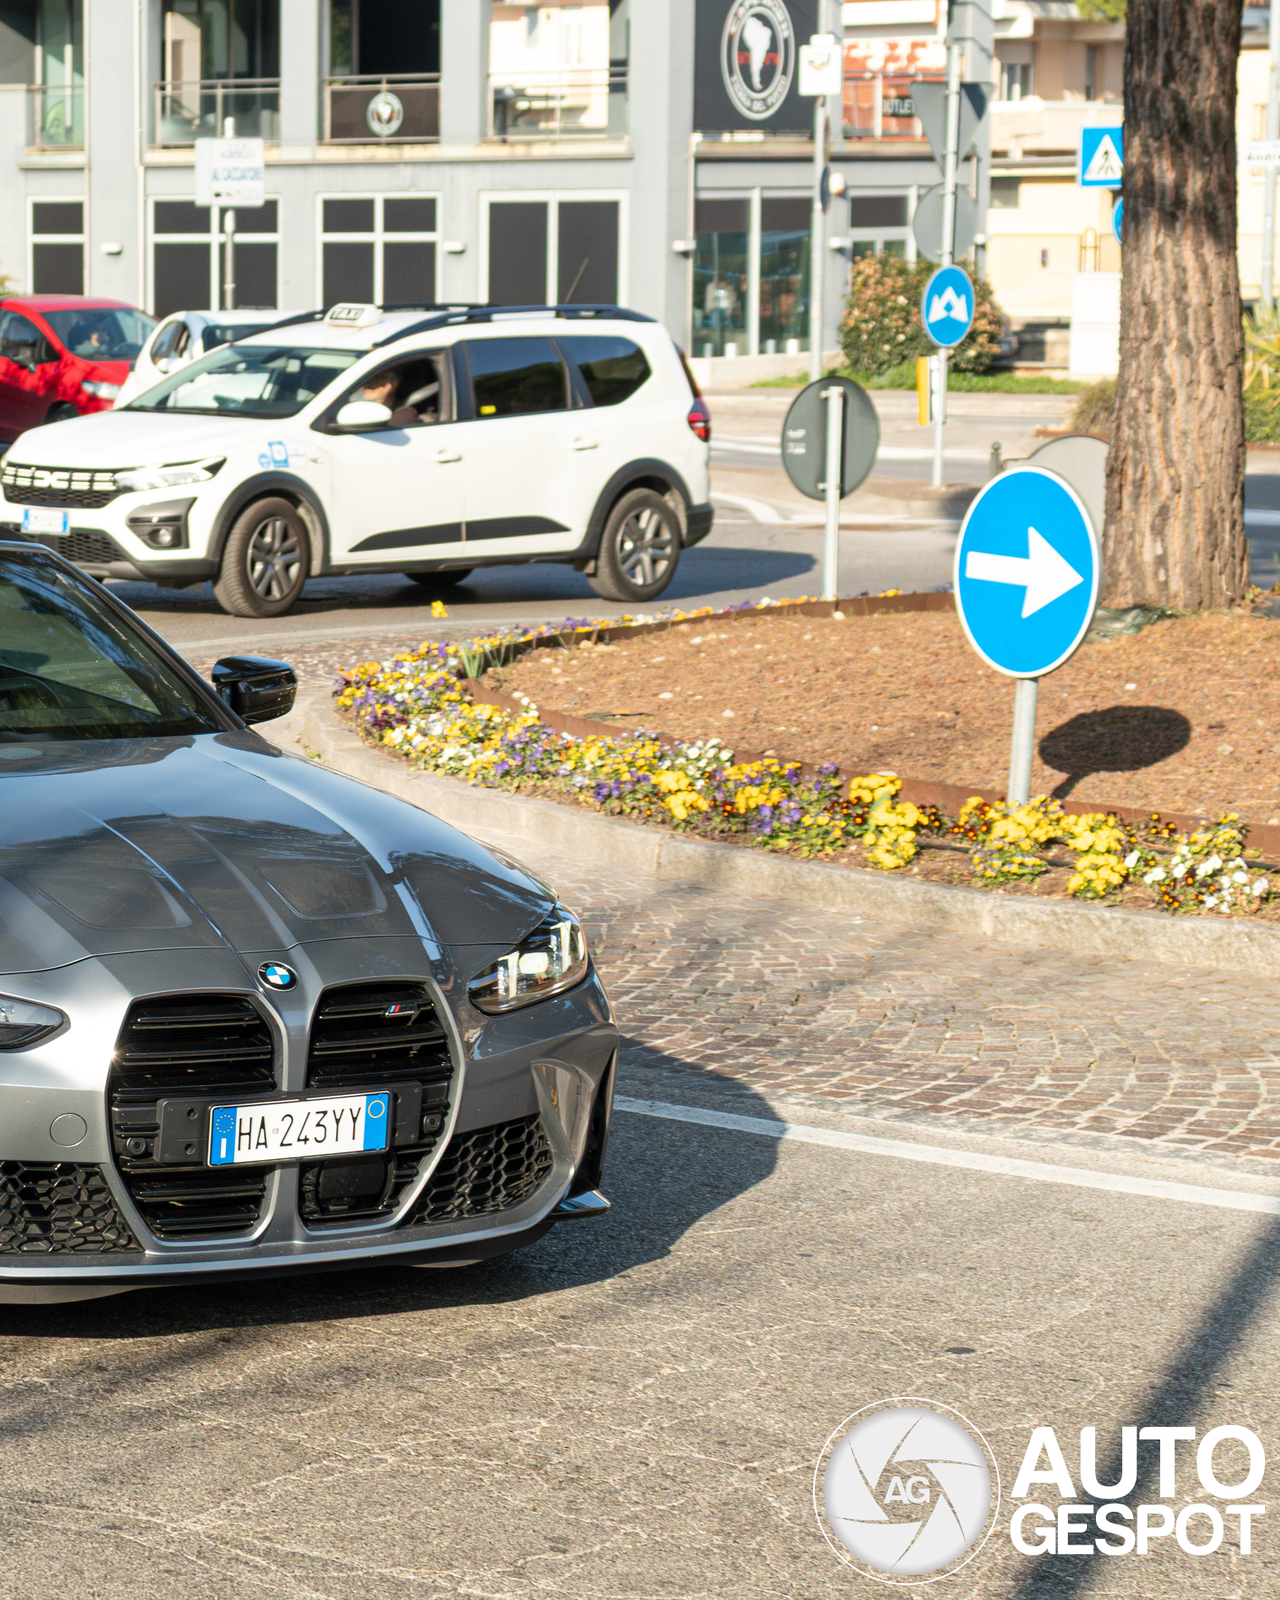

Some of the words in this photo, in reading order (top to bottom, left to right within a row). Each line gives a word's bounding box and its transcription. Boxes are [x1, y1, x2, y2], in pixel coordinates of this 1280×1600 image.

[331, 307, 364, 320] TAXI
[238, 1116, 269, 1151] HA
[279, 1107, 362, 1148] 243YY
